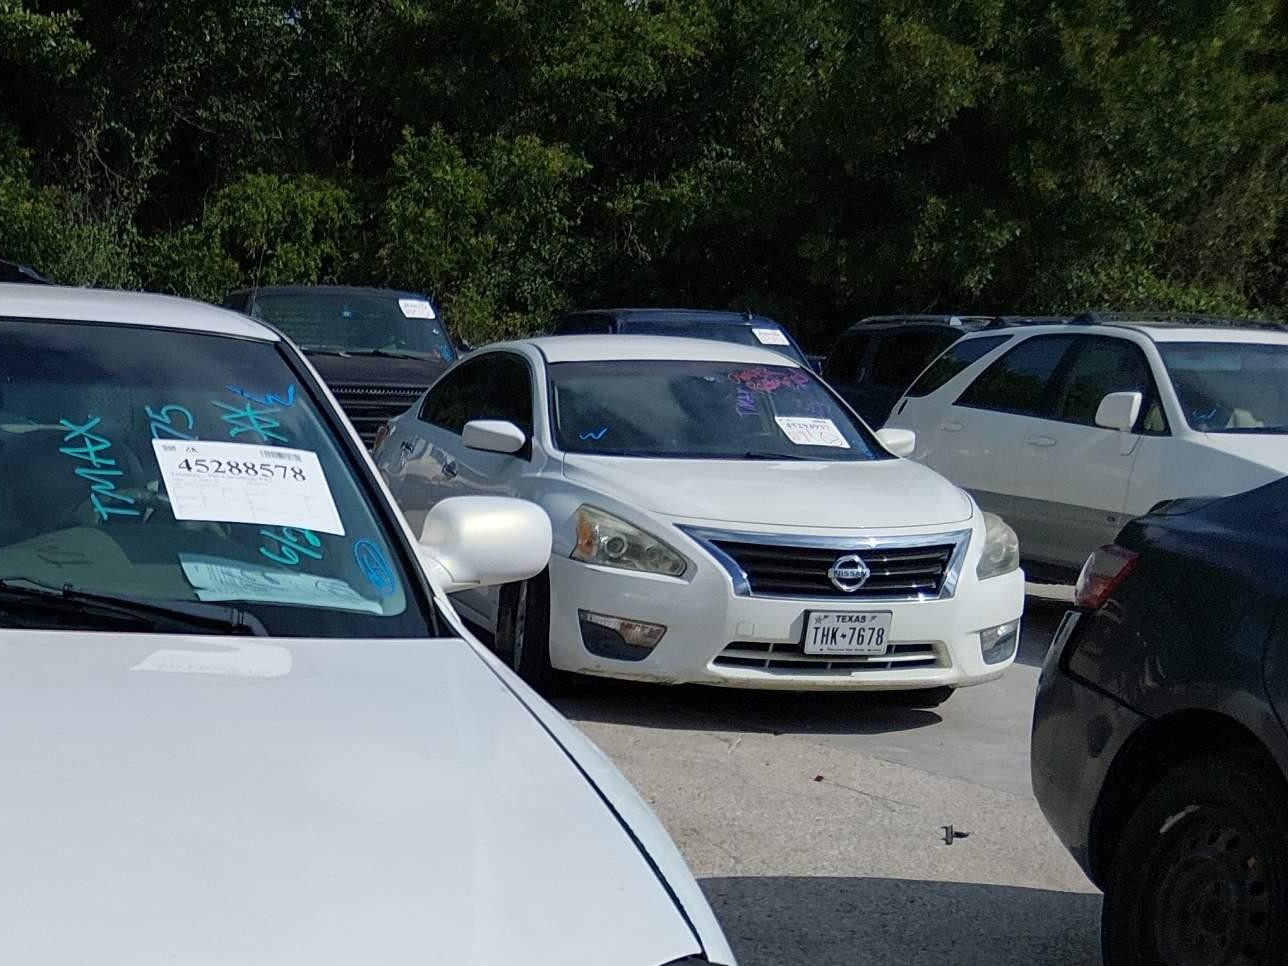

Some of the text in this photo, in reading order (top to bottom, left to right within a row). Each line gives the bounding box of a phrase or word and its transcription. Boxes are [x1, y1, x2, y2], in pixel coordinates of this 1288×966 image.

[59, 415, 141, 520] TMAX
[177, 457, 307, 482] 45288578
[833, 570, 867, 578] NISSAN
[836, 615, 867, 623] TEXAS
